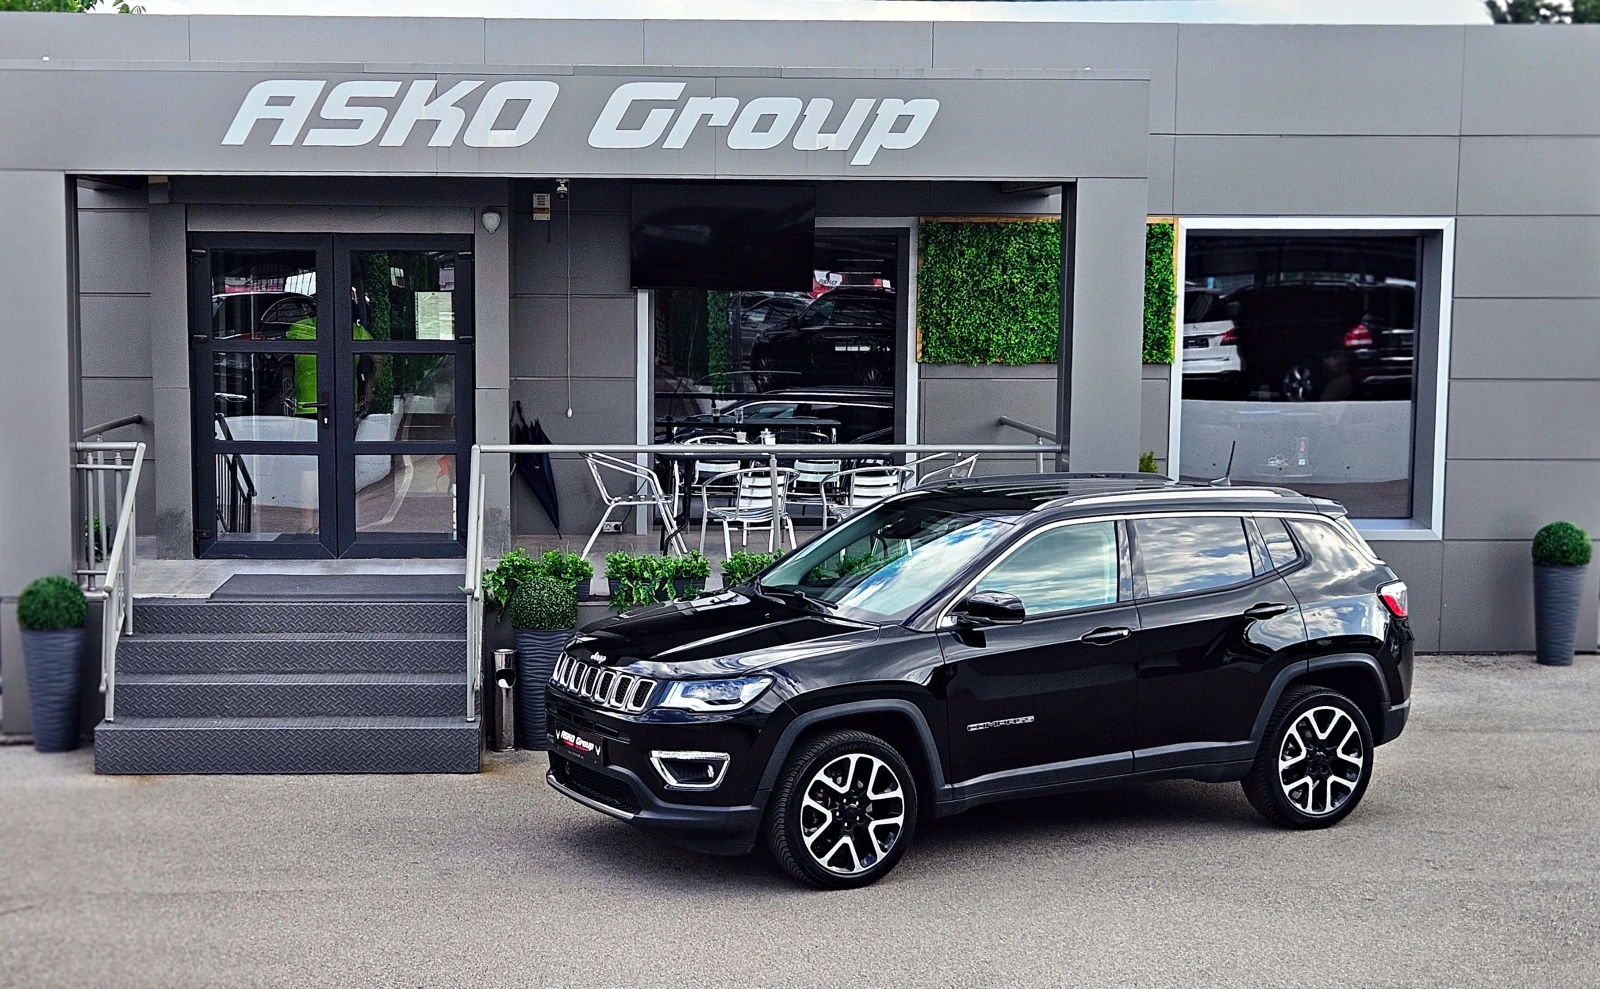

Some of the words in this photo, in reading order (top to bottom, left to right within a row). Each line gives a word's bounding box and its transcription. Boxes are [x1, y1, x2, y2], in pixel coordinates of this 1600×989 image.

[221, 79, 560, 147] ASKO
[587, 81, 940, 167] Group
[966, 715, 1035, 731] COMPASS
[560, 730, 576, 744] ASKO
[575, 736, 595, 752] Group
